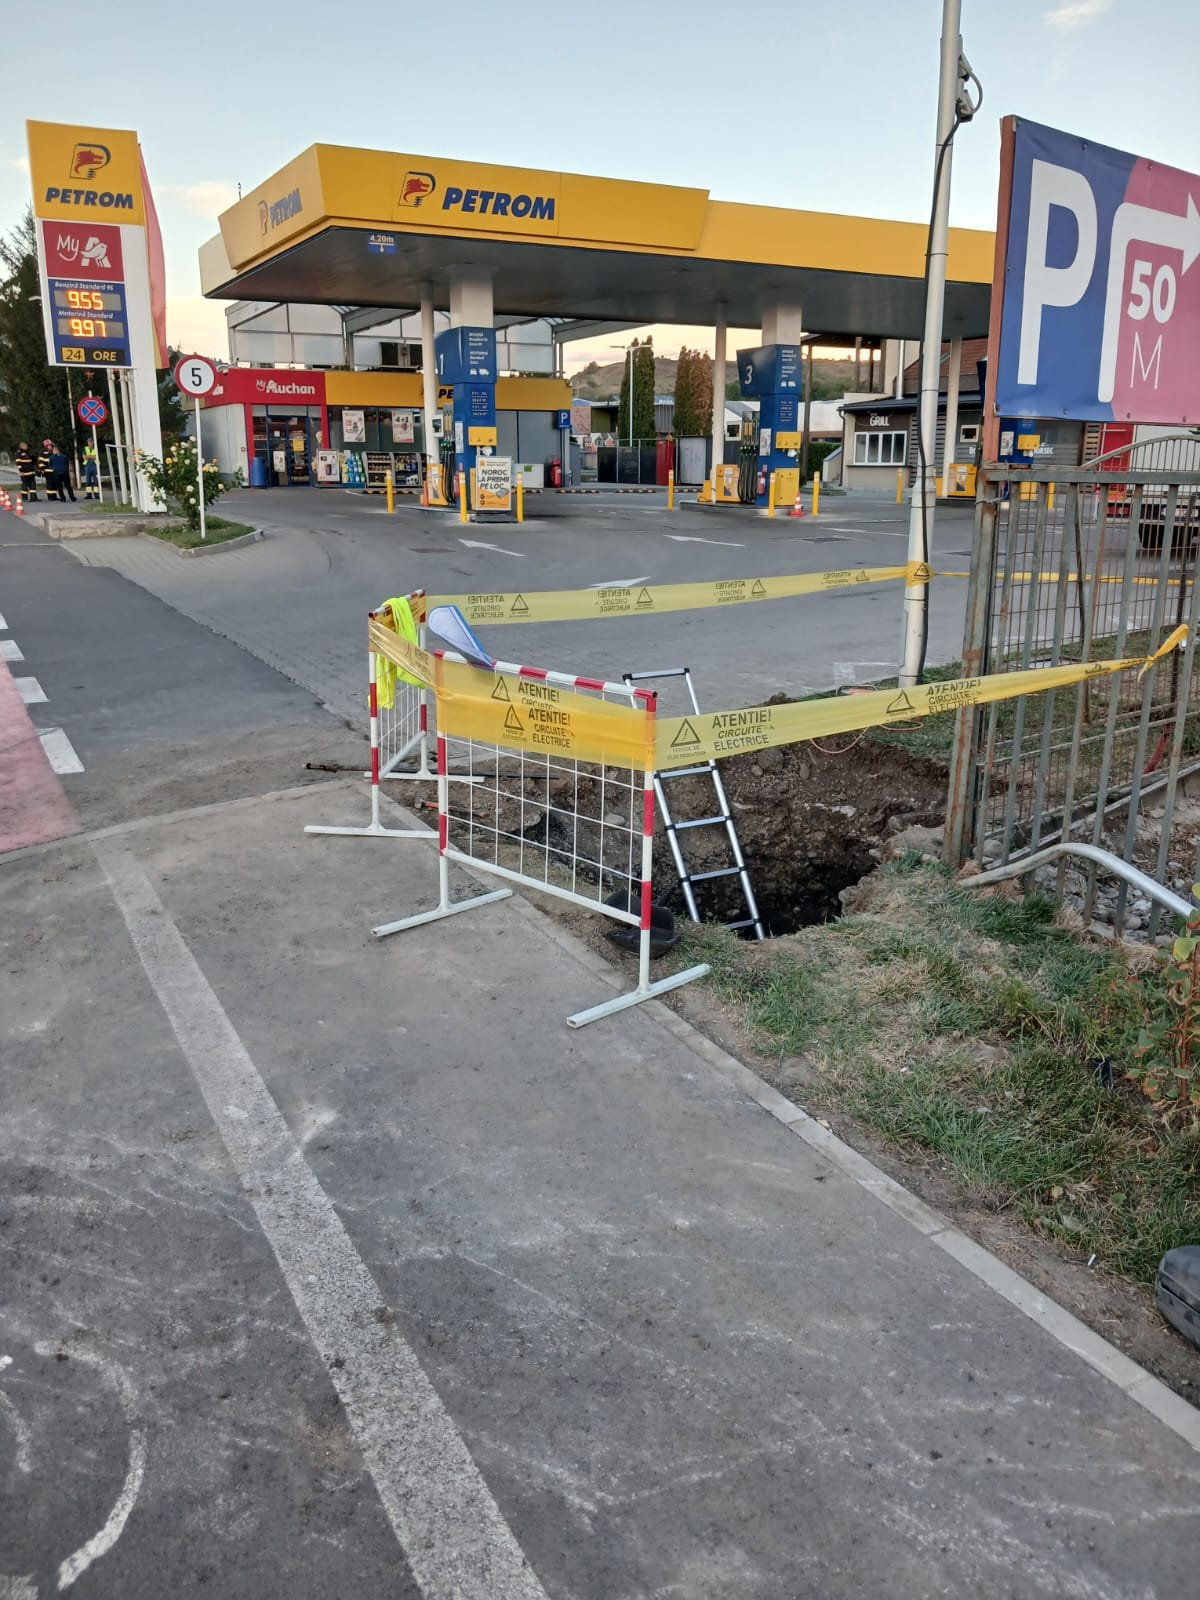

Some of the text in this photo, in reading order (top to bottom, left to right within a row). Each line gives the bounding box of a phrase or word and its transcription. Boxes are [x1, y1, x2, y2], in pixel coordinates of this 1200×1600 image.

[46, 187, 133, 209] PETROM
[442, 187, 555, 220] PETROM
[270, 188, 303, 229] PETROM
[57, 234, 79, 261] My
[1017, 159, 1098, 385] P
[1127, 259, 1176, 324] 50
[66, 349, 117, 361] 24 ORE
[440, 353, 444, 375] 1
[1130, 332, 1162, 390] M
[191, 367, 202, 387] 5
[744, 365, 753, 385] 3
[266, 380, 316, 395] Auchan
[561, 412, 568, 424] P
[869, 416, 890, 427] GRILL
[518, 681, 560, 703] ATENTIE!
[926, 679, 981, 696] ATENTIE!
[928, 690, 971, 705] CIRCUITE
[528, 708, 571, 726] ATENTIE!
[712, 709, 772, 729] ATENTIE!
[534, 723, 567, 737] CIRCUITE
[717, 724, 763, 739] CIRCUITE
[532, 733, 571, 748] ELECTRICE
[714, 735, 769, 751] ELECTRICE
